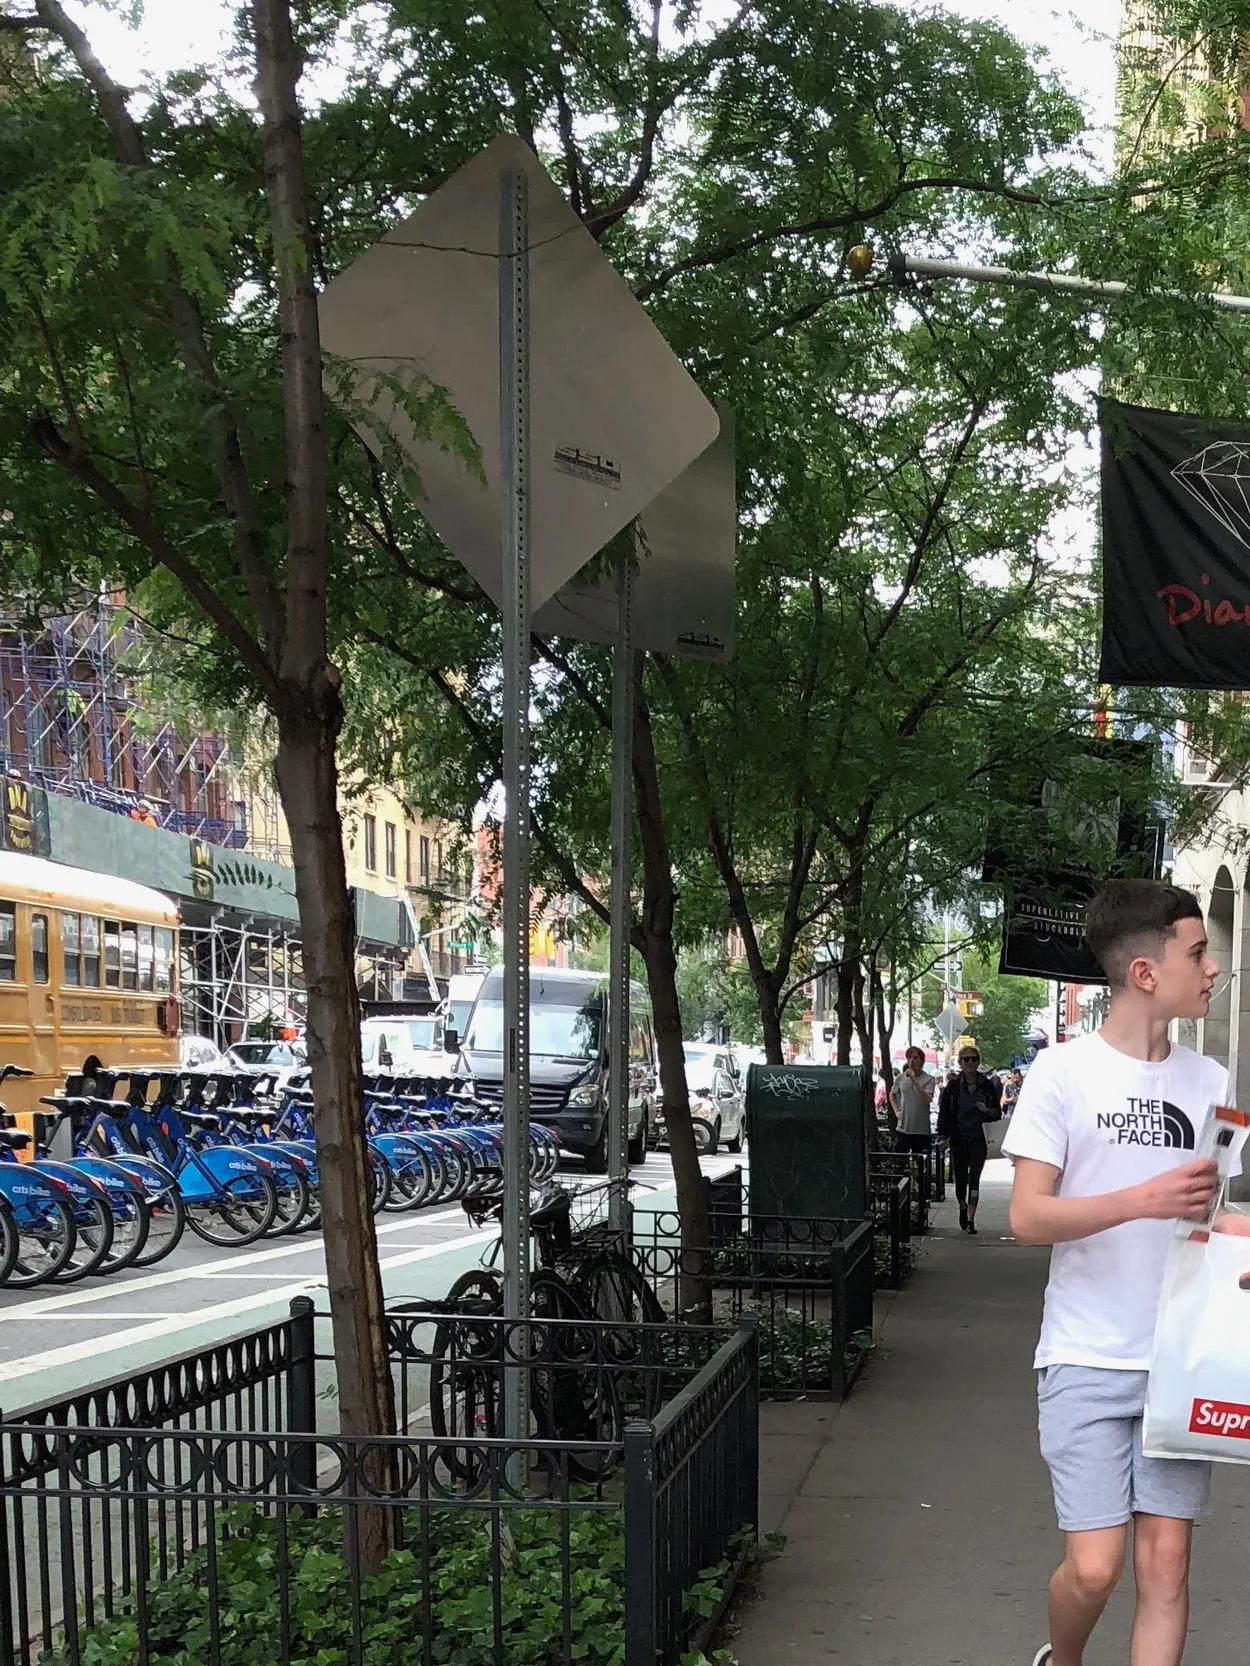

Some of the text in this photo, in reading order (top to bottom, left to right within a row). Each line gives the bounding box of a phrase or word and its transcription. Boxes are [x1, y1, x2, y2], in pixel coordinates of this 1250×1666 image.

[1126, 1098, 1161, 1114] THE
[1097, 1113, 1163, 1130] NORTH
[1118, 1129, 1162, 1147] FACE
